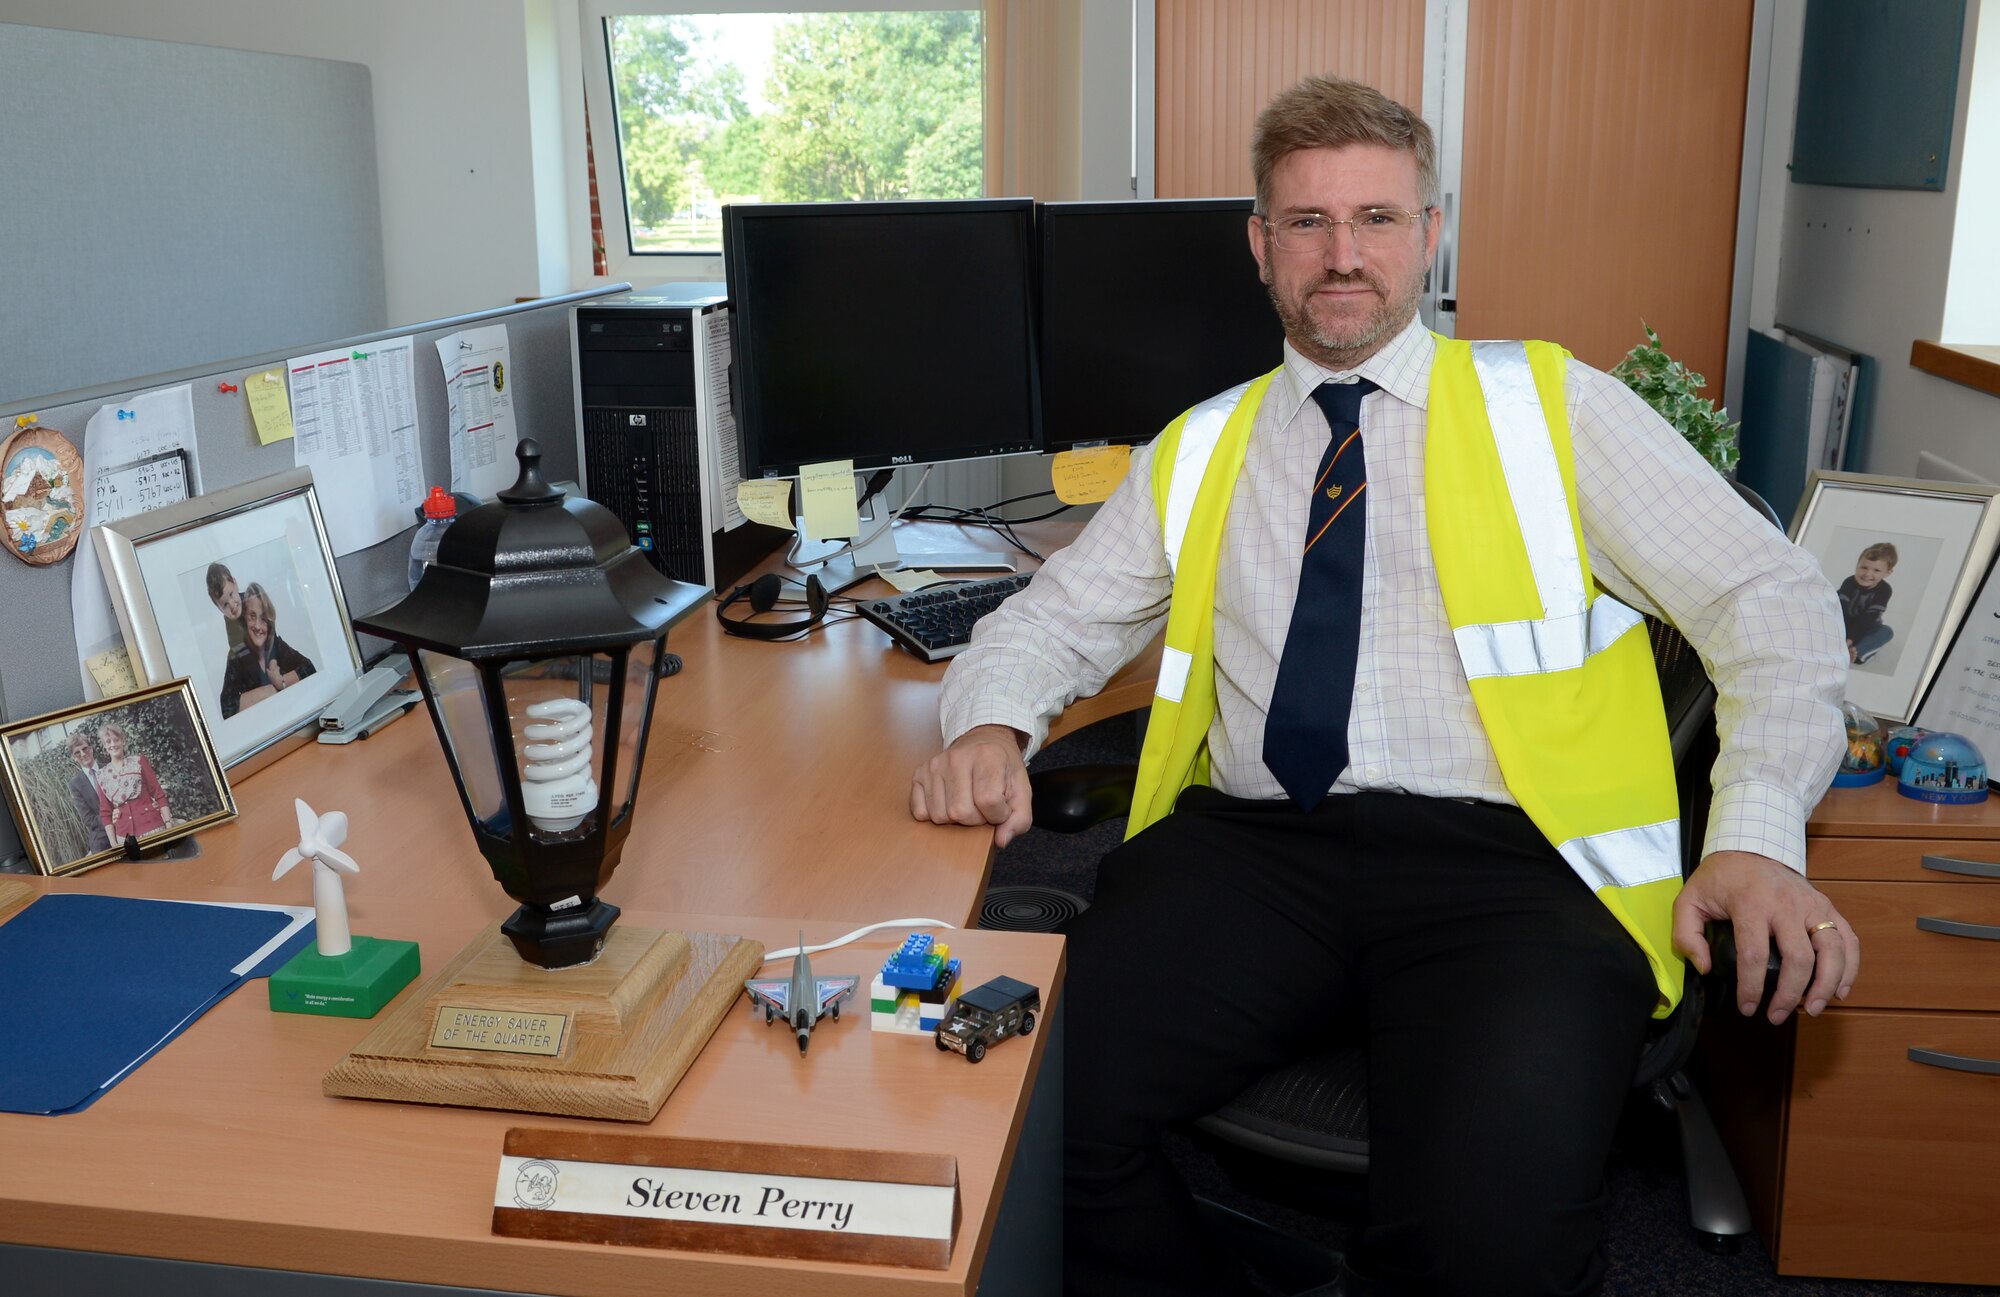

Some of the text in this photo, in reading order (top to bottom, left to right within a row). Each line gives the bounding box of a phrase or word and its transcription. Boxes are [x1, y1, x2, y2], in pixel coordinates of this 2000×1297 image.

[892, 455, 913, 464] DELL
[97, 500, 112, 518] FY
[1921, 792, 1946, 801] NEW
[455, 1013, 548, 1032] ENERGY SAVER
[443, 1028, 551, 1048] OF THE QUARTER
[626, 1177, 854, 1230] Steven Perry
